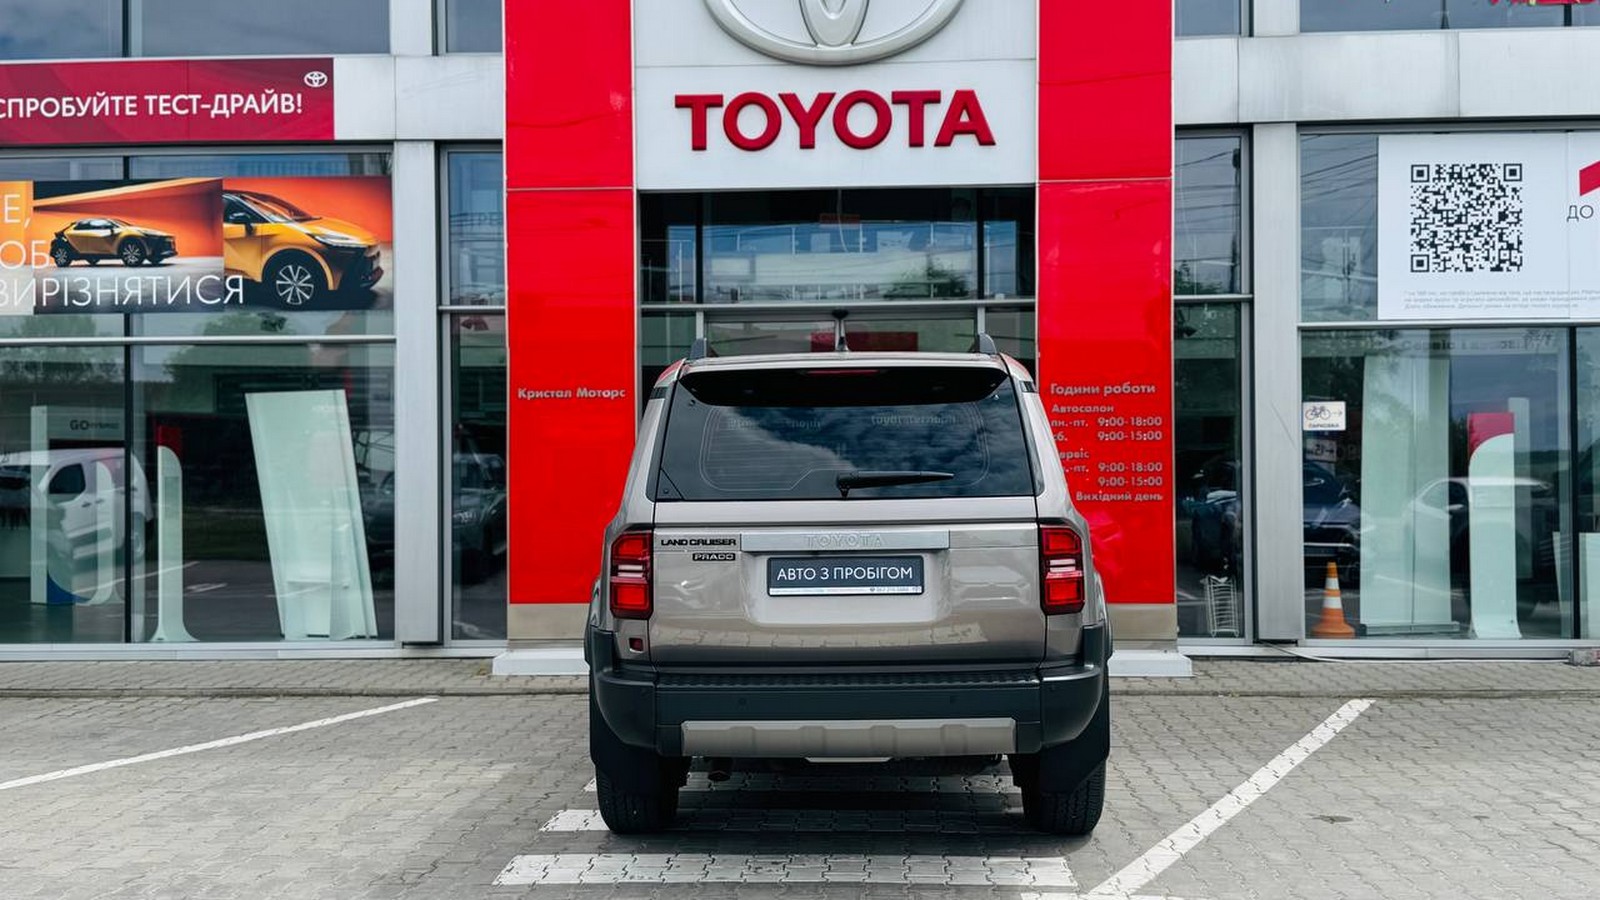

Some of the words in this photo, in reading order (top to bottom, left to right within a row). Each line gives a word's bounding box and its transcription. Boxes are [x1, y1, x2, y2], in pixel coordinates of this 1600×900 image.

[145, 89, 302, 118] ТЕСТ-ДРАЙВ!
[675, 90, 996, 151] TOYOTA
[1566, 204, 1594, 222] ДО
[518, 387, 572, 400] Кристал
[576, 387, 626, 400] Моторс
[1050, 383, 1100, 396] Години
[1103, 382, 1156, 397] роботи
[1051, 404, 1115, 413] Автосалон
[1097, 416, 1163, 427] 9:00-18:00
[1097, 430, 1163, 440] 9:00-15:00
[1076, 490, 1132, 501] Вихідний
[1135, 492, 1164, 501] день
[660, 538, 688, 547] LAND
[689, 538, 737, 547] CRUISER
[805, 533, 885, 548] TOYOTA
[693, 553, 735, 561] PRADO
[776, 567, 816, 581] АВТО
[833, 566, 913, 580] ПРОБІГОМ
